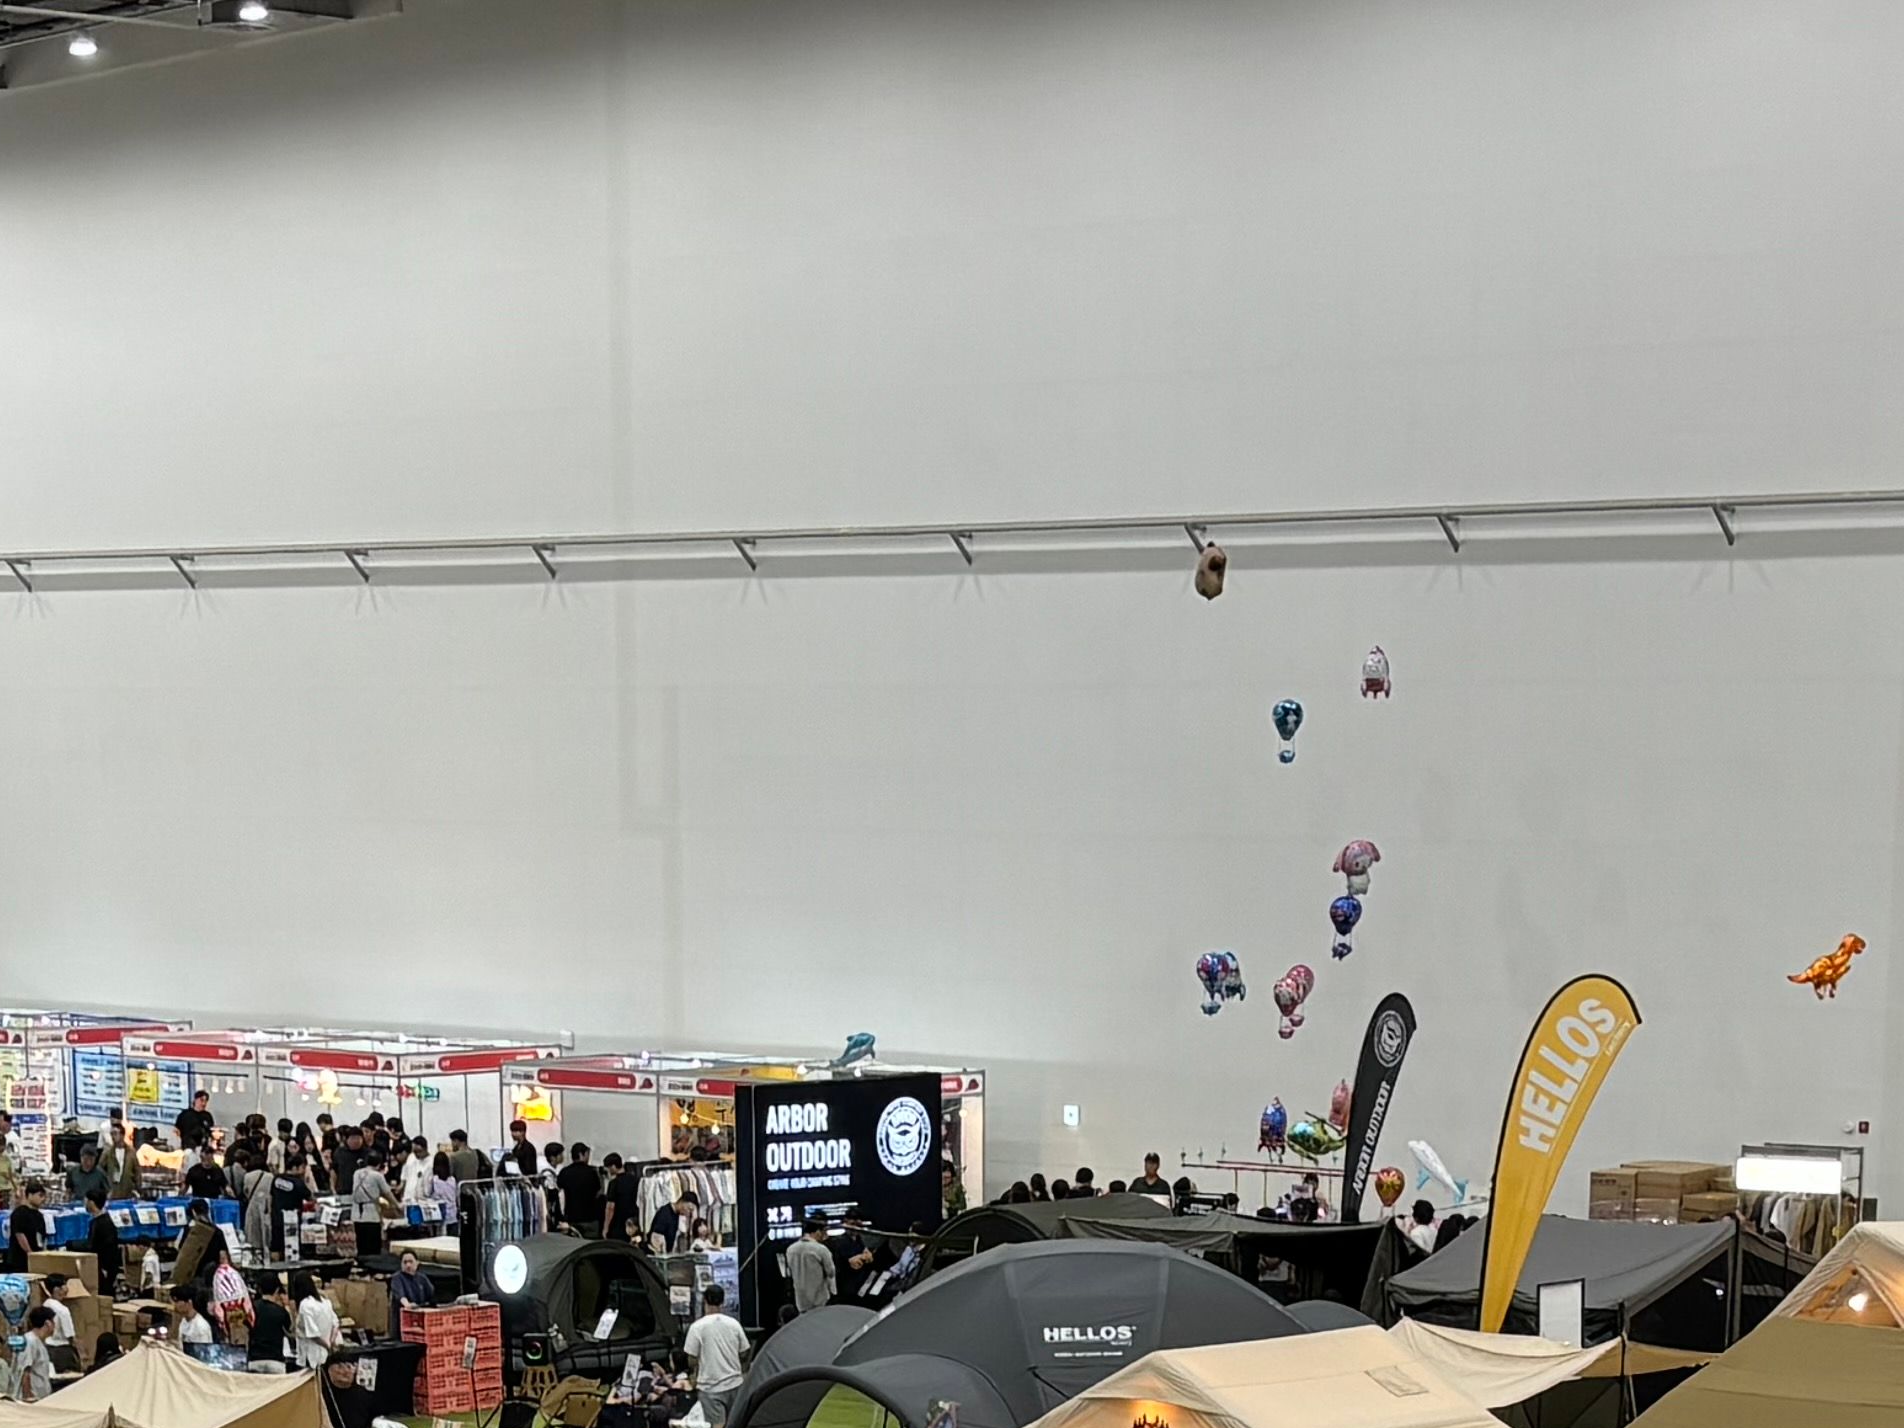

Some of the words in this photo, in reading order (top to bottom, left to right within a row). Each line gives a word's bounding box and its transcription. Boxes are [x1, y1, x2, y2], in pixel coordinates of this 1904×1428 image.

[1519, 997, 1617, 1155] HELLOS
[766, 1102, 829, 1134] ARBOR
[766, 1138, 852, 1173] OUTDOOR
[1044, 1325, 1133, 1343] HELLOS
